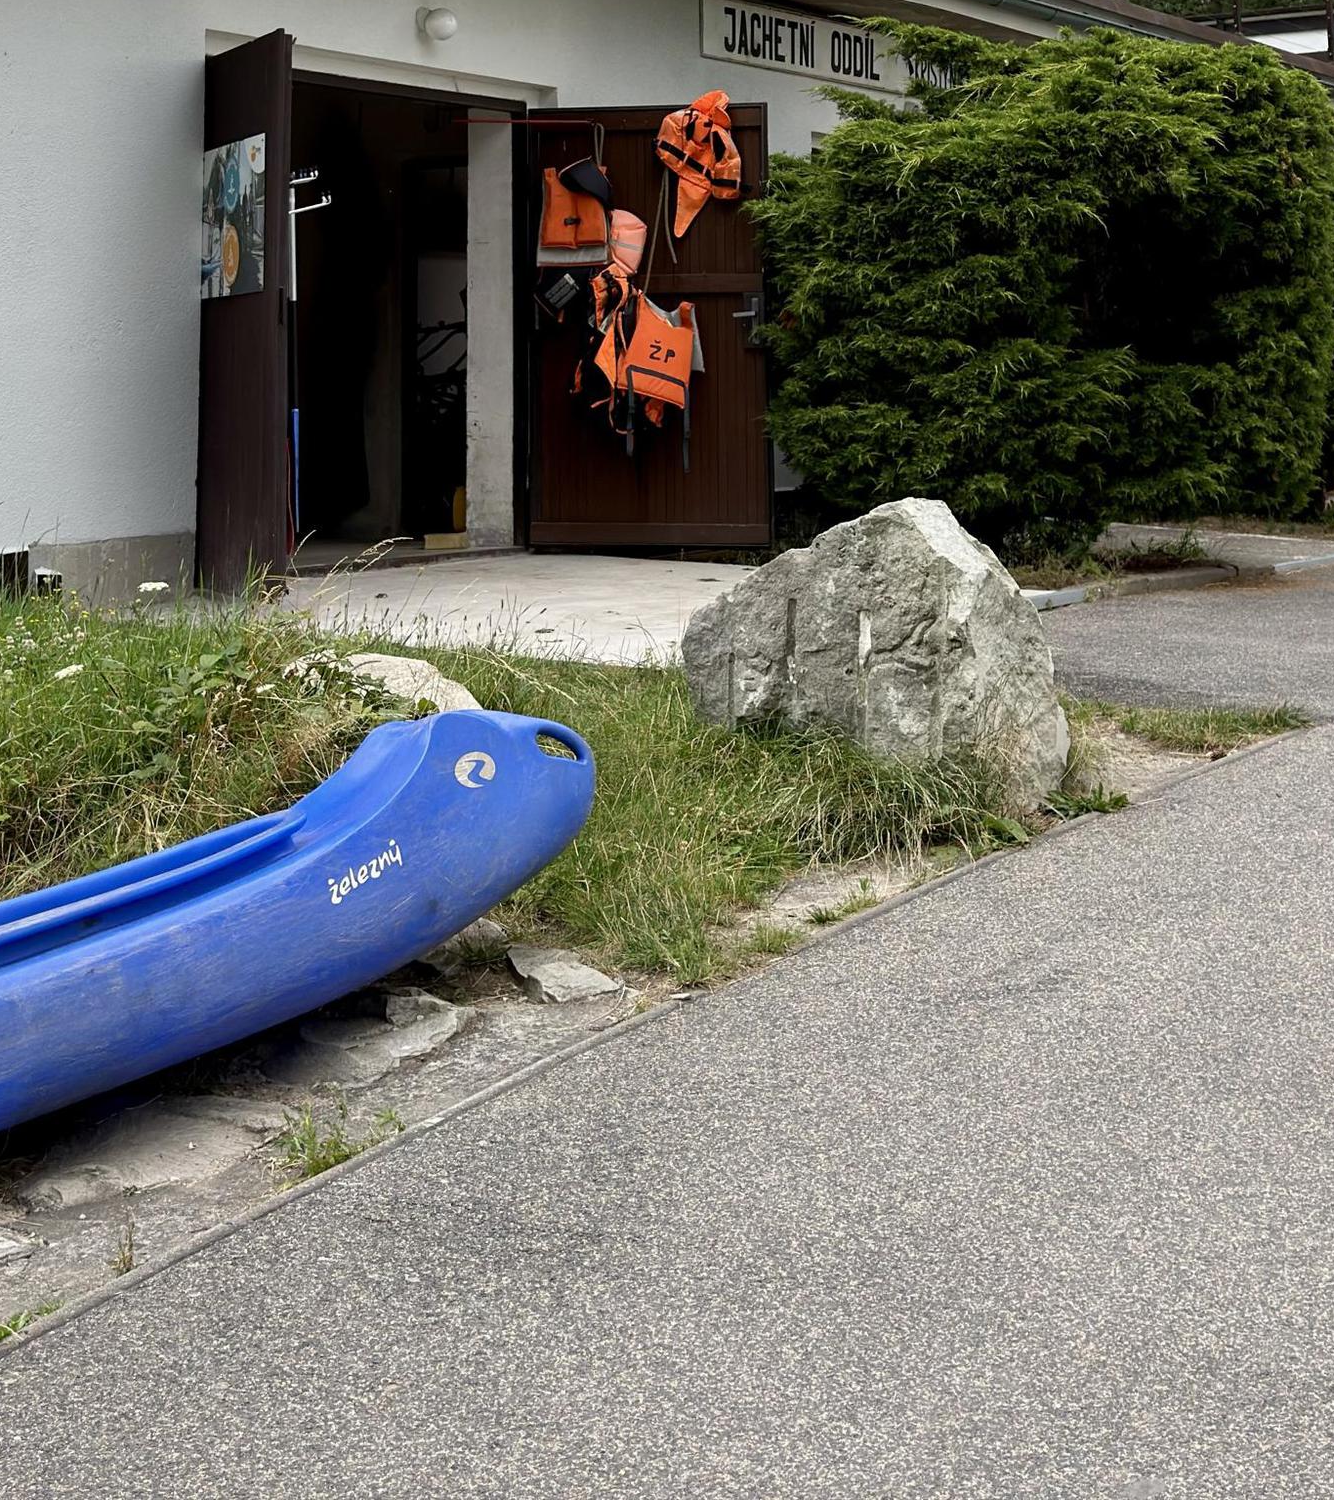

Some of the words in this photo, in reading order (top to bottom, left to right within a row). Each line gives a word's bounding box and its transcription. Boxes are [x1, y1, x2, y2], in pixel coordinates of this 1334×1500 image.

[723, 6, 816, 69] JACHETNÍ
[830, 30, 880, 81] ODDÍL
[648, 339, 676, 363] ŽP
